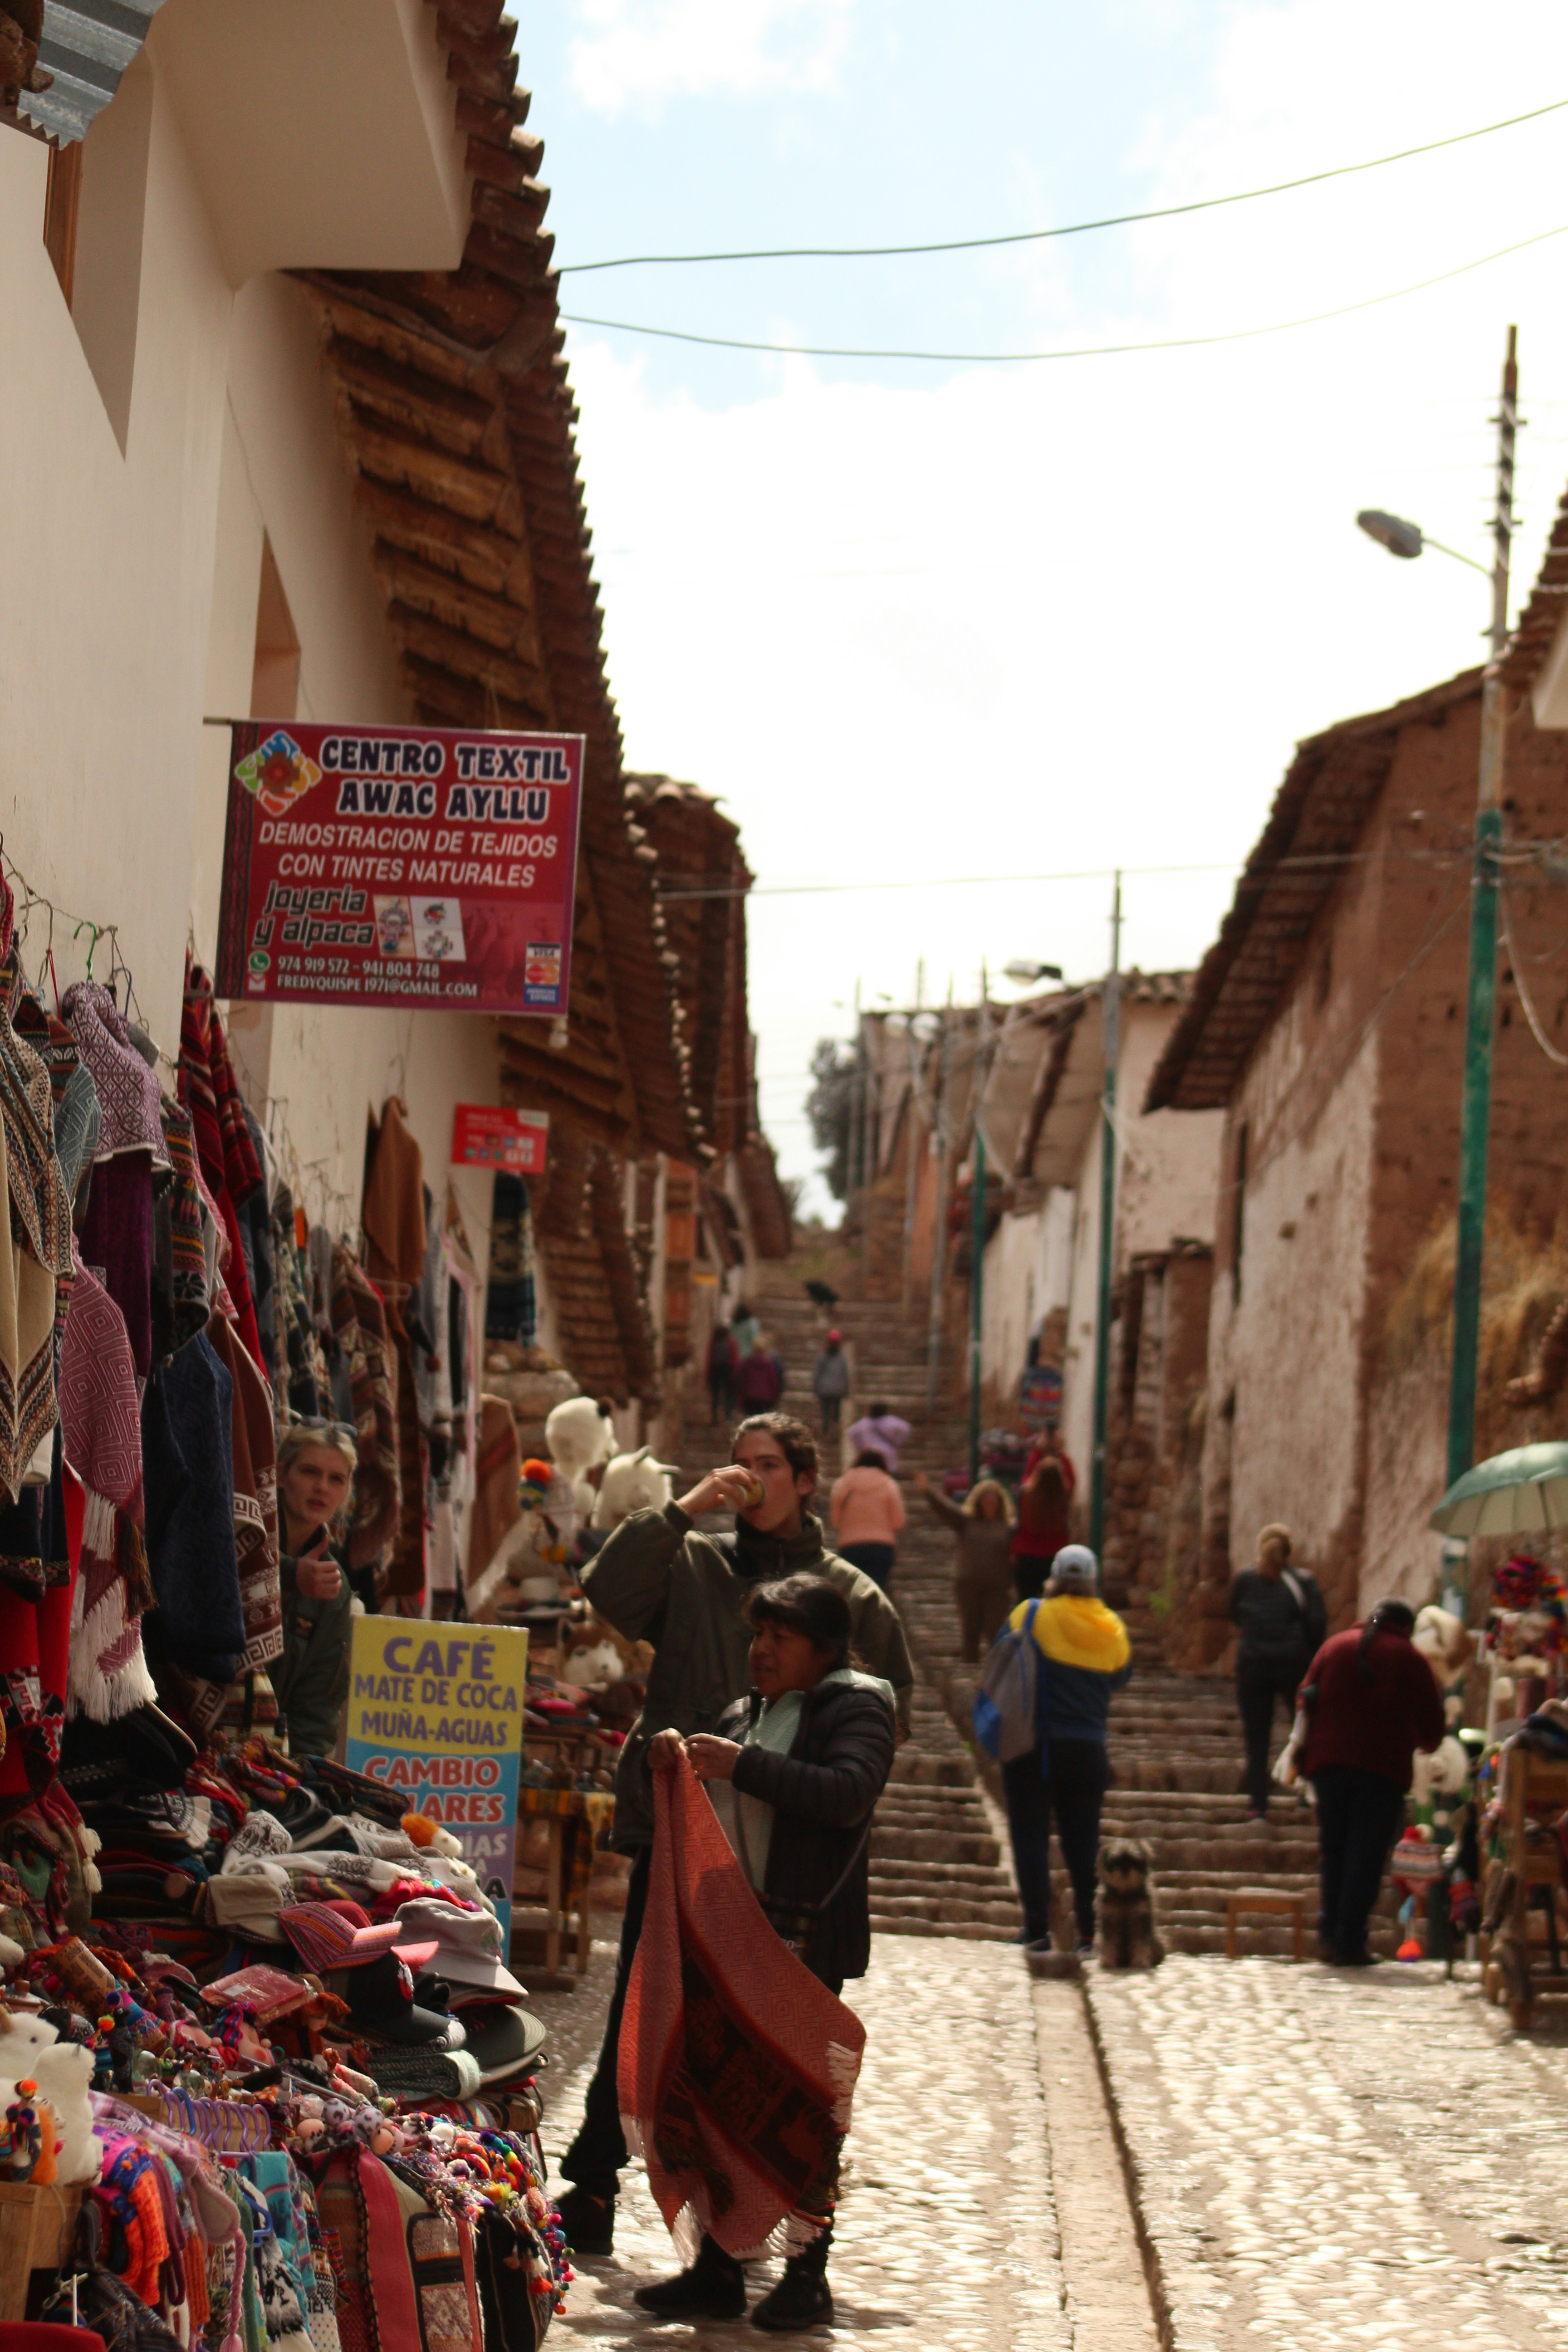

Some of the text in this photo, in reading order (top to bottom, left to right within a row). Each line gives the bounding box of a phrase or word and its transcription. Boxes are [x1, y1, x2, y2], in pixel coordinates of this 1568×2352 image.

[320, 736, 570, 784] CENTRO TEXTIL
[337, 778, 549, 824] AWAC AYLLU
[259, 820, 558, 858] DEMOSTRACION DE TEJIDOS
[279, 853, 536, 888] CON TINTES NATURALES
[253, 914, 374, 950] y alpaca
[277, 974, 362, 992] FREDYQUISPE
[278, 955, 301, 971] 974
[304, 956, 326, 973] 919
[328, 957, 349, 974] 572
[363, 959, 383, 975] 941
[386, 961, 412, 977] 804
[416, 962, 440, 979] 748
[383, 1635, 495, 1680] CAFÉ
[355, 1673, 518, 1712] MATE DE COCA
[361, 1708, 508, 1747] MUÑA-AGUAS
[363, 1756, 501, 1788] CAMBIO
[405, 1793, 505, 1824] ARES
